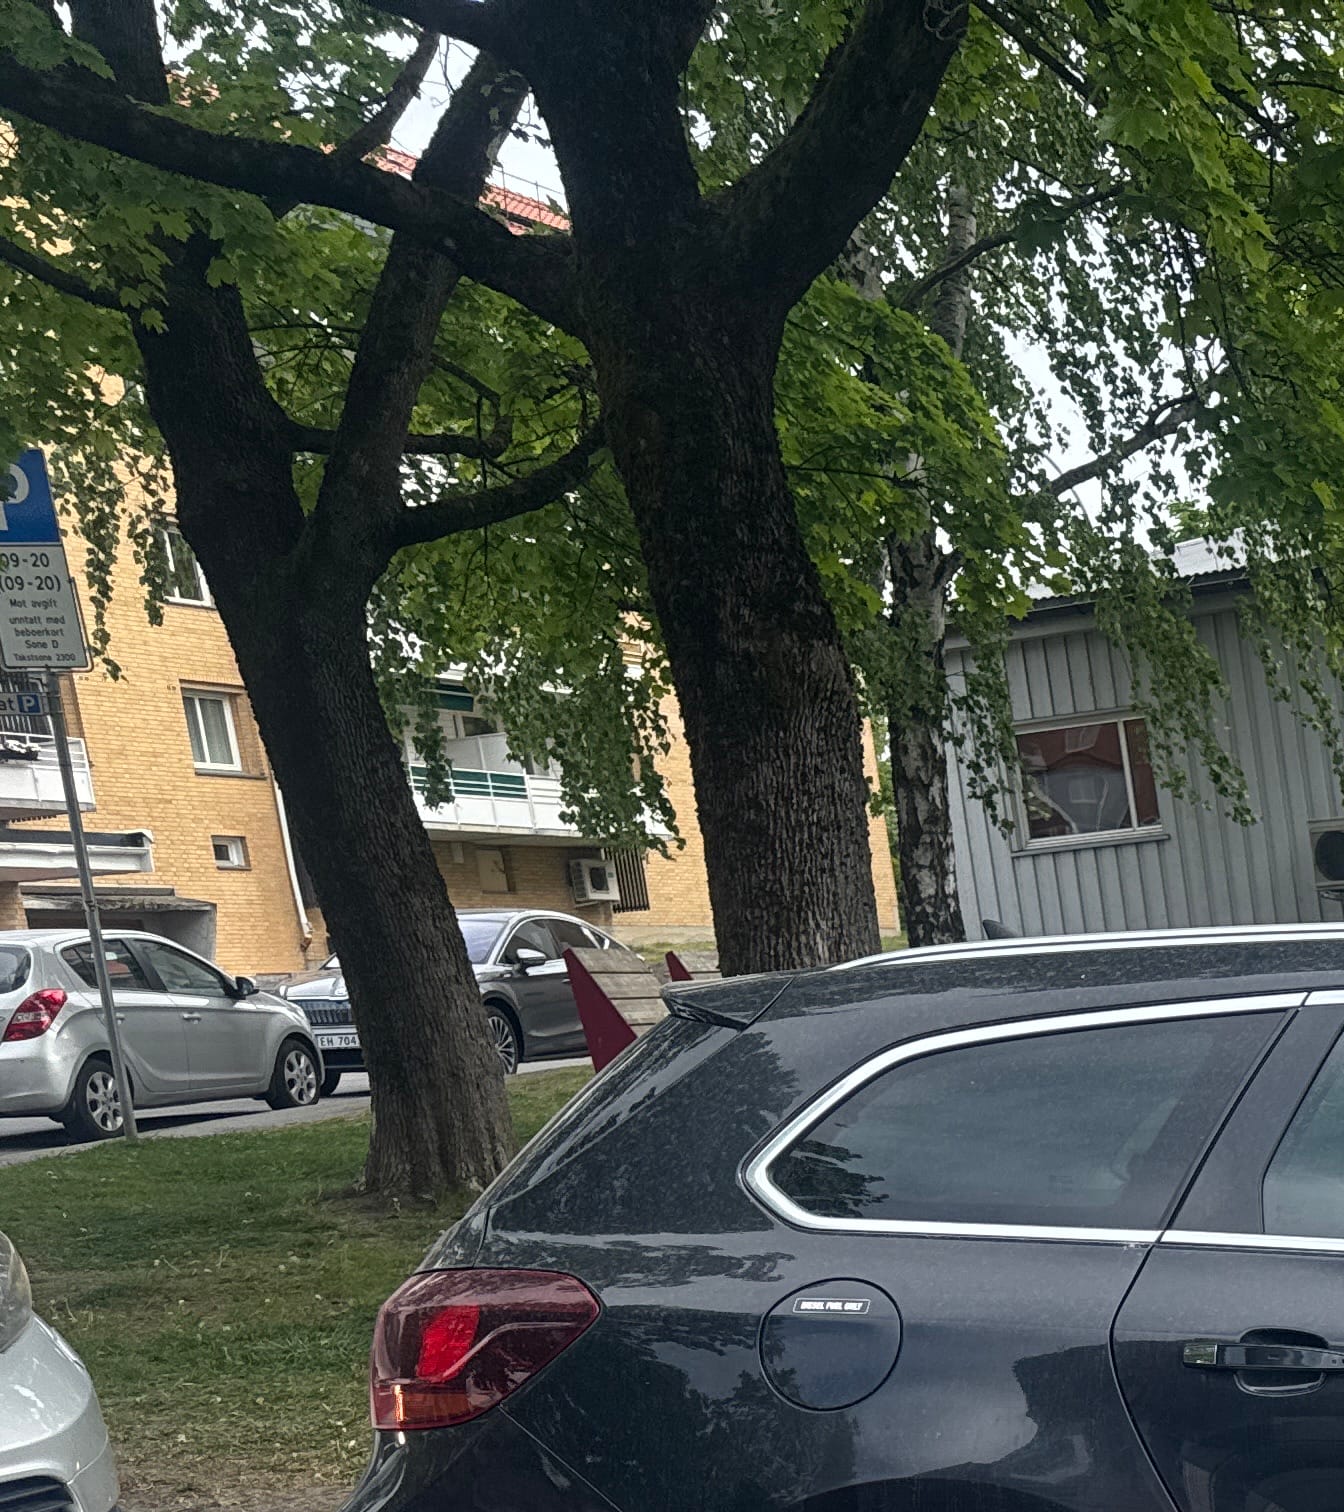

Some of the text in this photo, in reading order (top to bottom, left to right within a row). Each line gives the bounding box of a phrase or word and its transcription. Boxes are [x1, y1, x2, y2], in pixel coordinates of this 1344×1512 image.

[9, 598, 58, 610] Mot avgift
[9, 615, 66, 625] unntatt med
[14, 627, 64, 637] beboerkort
[25, 640, 48, 649] Sone
